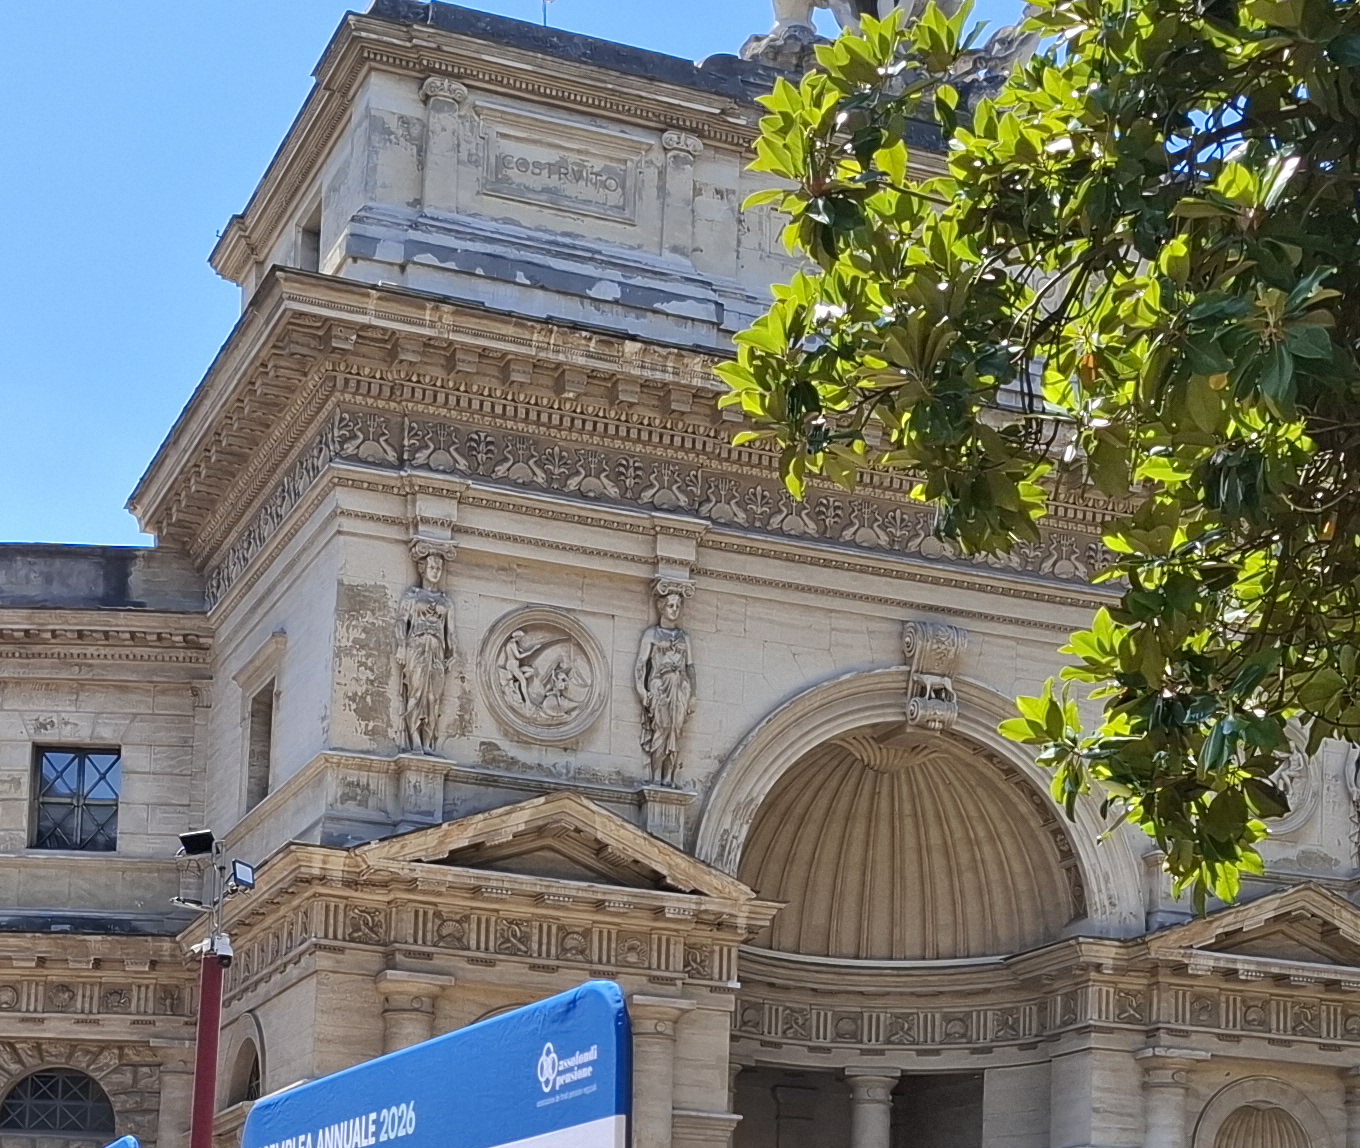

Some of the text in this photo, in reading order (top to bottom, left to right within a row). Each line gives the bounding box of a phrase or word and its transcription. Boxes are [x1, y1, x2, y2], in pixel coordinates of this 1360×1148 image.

[501, 153, 620, 193] COSTRVITO
[555, 1066, 593, 1091] pensione
[379, 1100, 416, 1142] 2026
